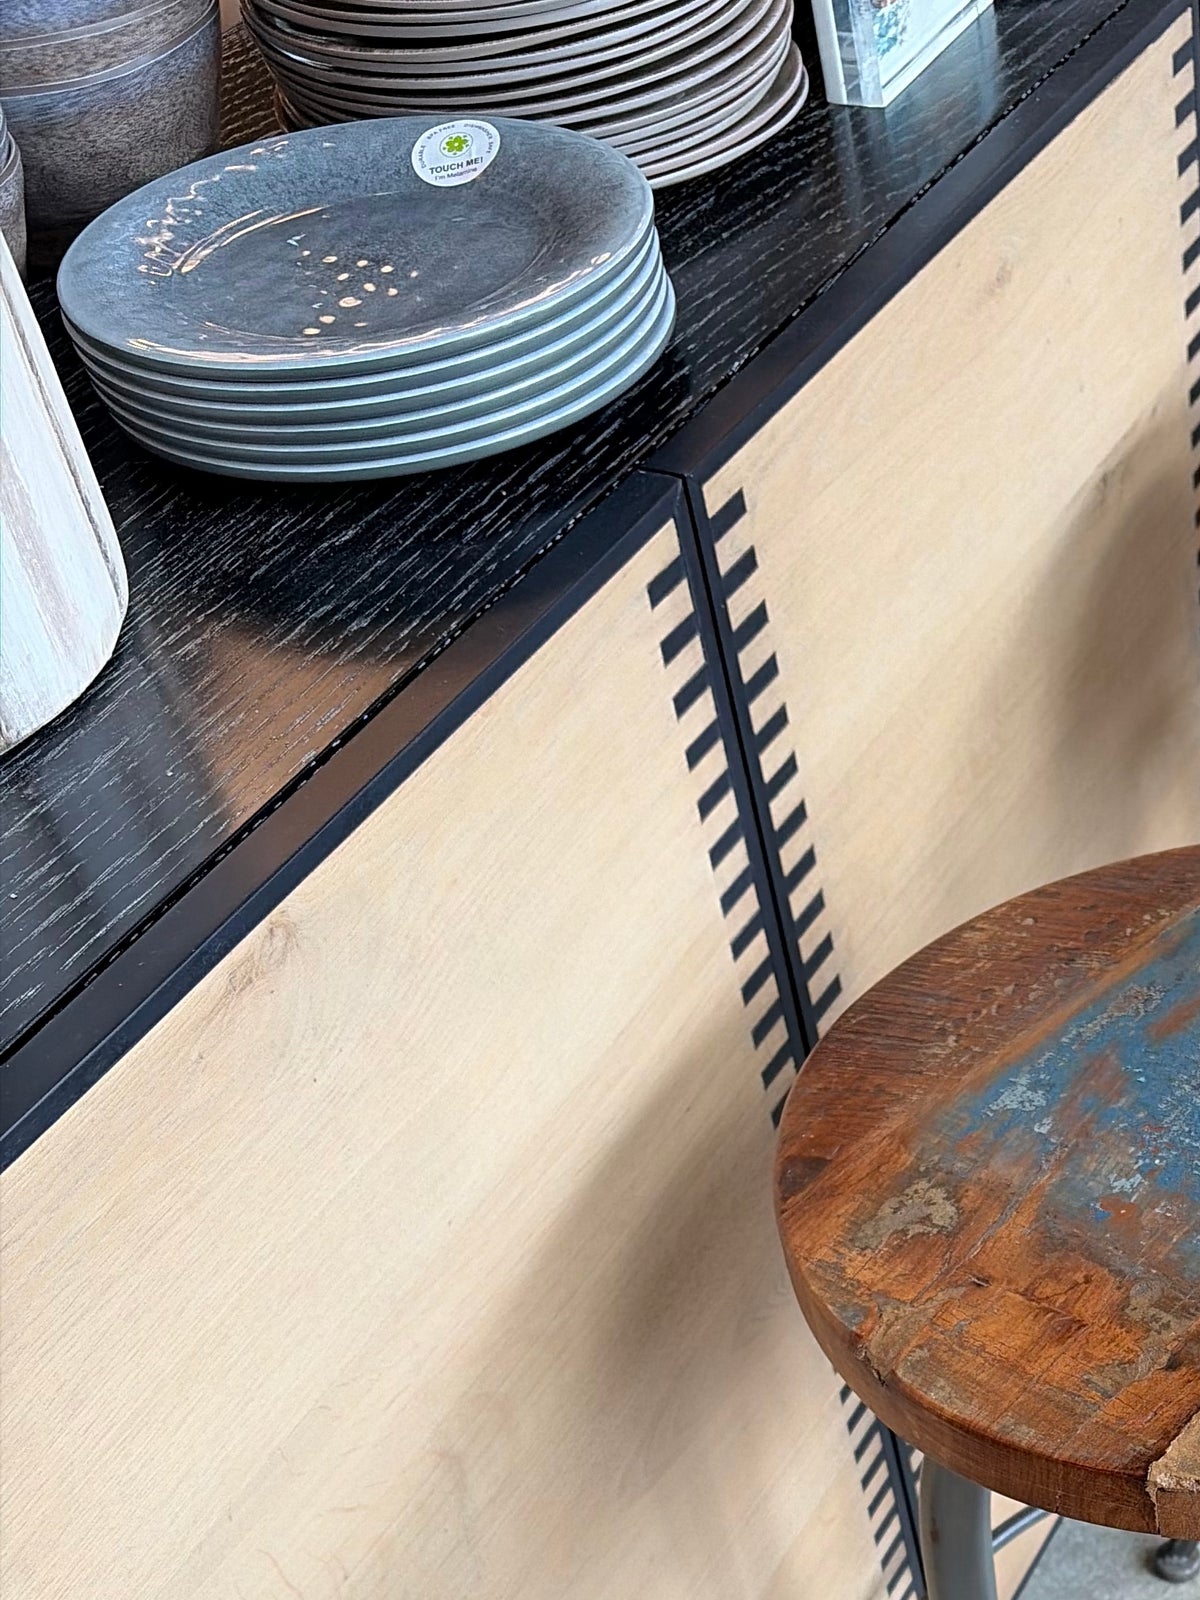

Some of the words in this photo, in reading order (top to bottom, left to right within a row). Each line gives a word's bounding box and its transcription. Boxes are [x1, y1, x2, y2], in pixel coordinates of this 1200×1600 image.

[429, 162, 464, 175] TOUCH
[466, 156, 484, 167] ME!
[447, 167, 478, 178] Melamine
